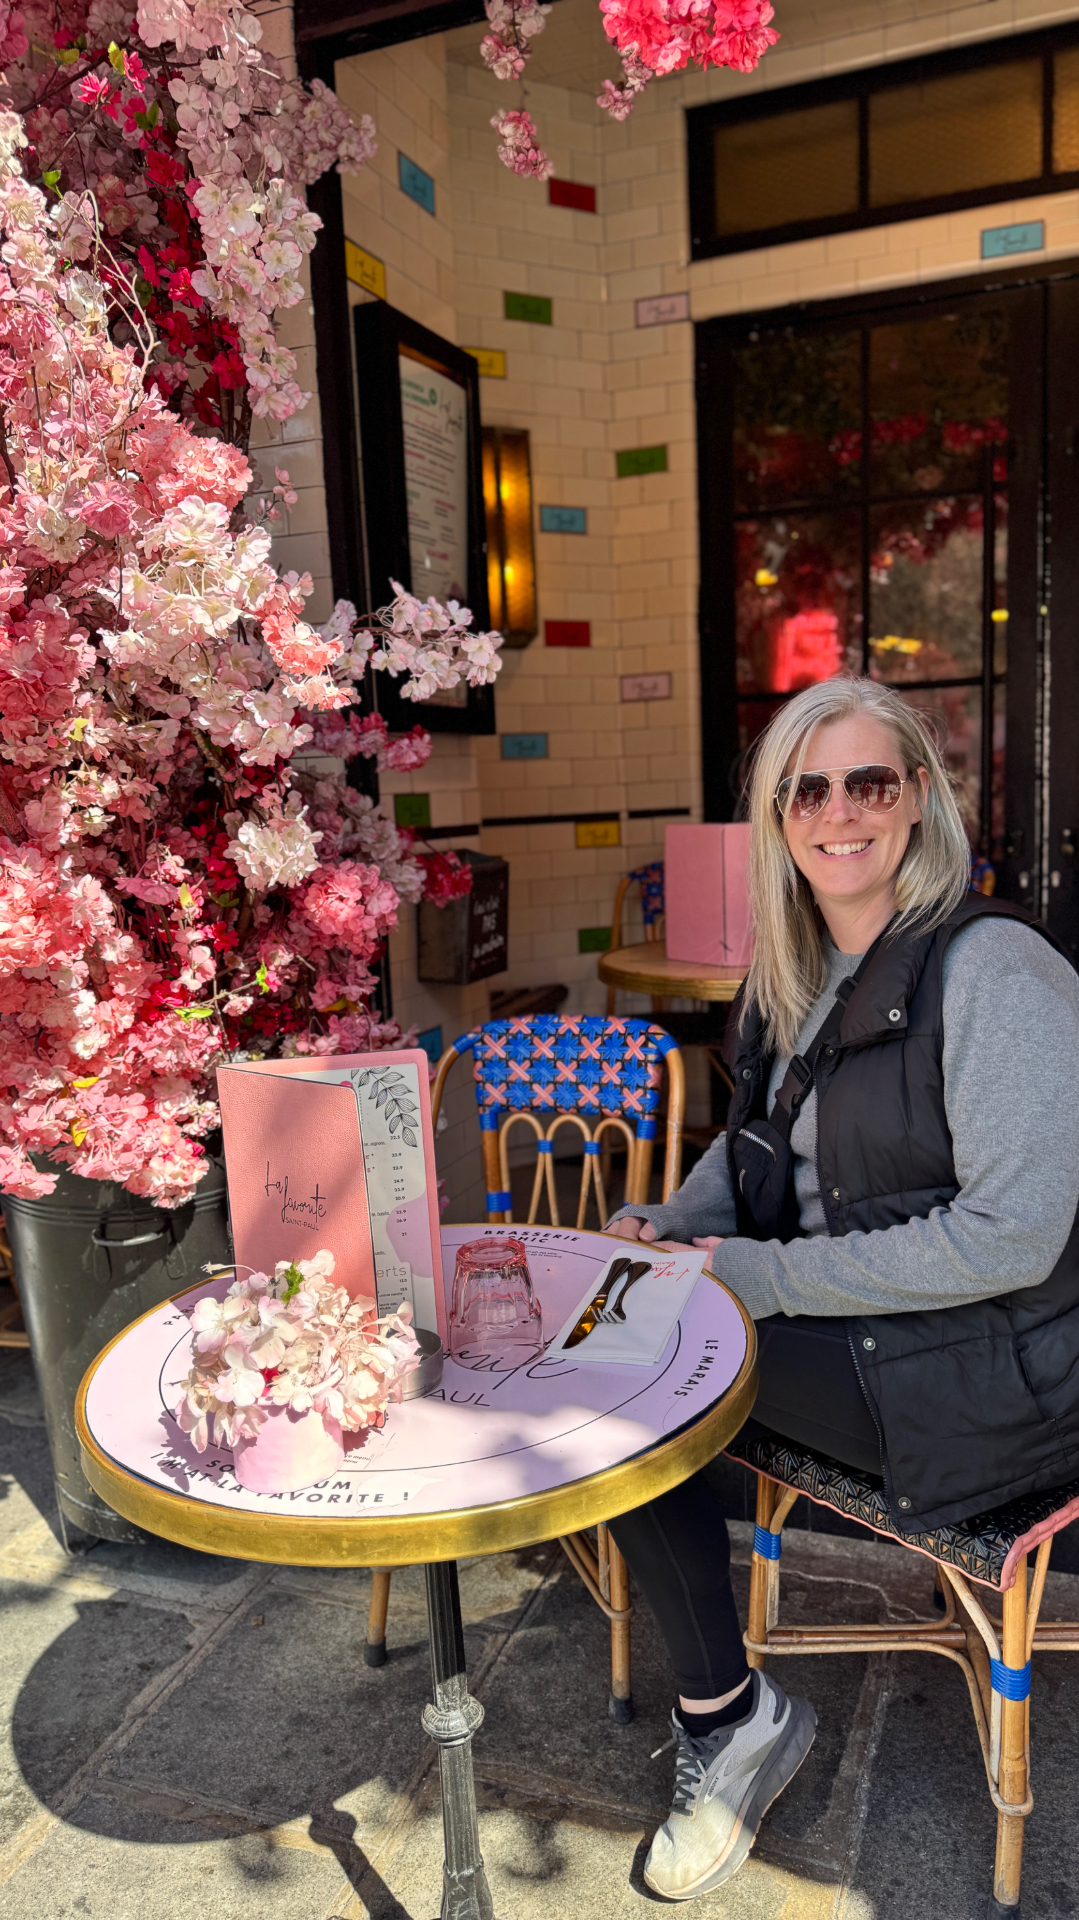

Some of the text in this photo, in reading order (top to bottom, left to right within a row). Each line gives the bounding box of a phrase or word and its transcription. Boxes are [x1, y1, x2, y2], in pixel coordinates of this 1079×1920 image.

[264, 1161, 284, 1197] La
[281, 1175, 327, 1224] favorite
[285, 1217, 320, 1232] SAINT-PAUL
[484, 1230, 580, 1242] BRASSERIE
[376, 1266, 407, 1278] erts
[673, 1340, 719, 1397] LE MARAIS
[183, 1469, 213, 1482] AT
[217, 1479, 244, 1493] LA
[403, 1491, 408, 1500] !
